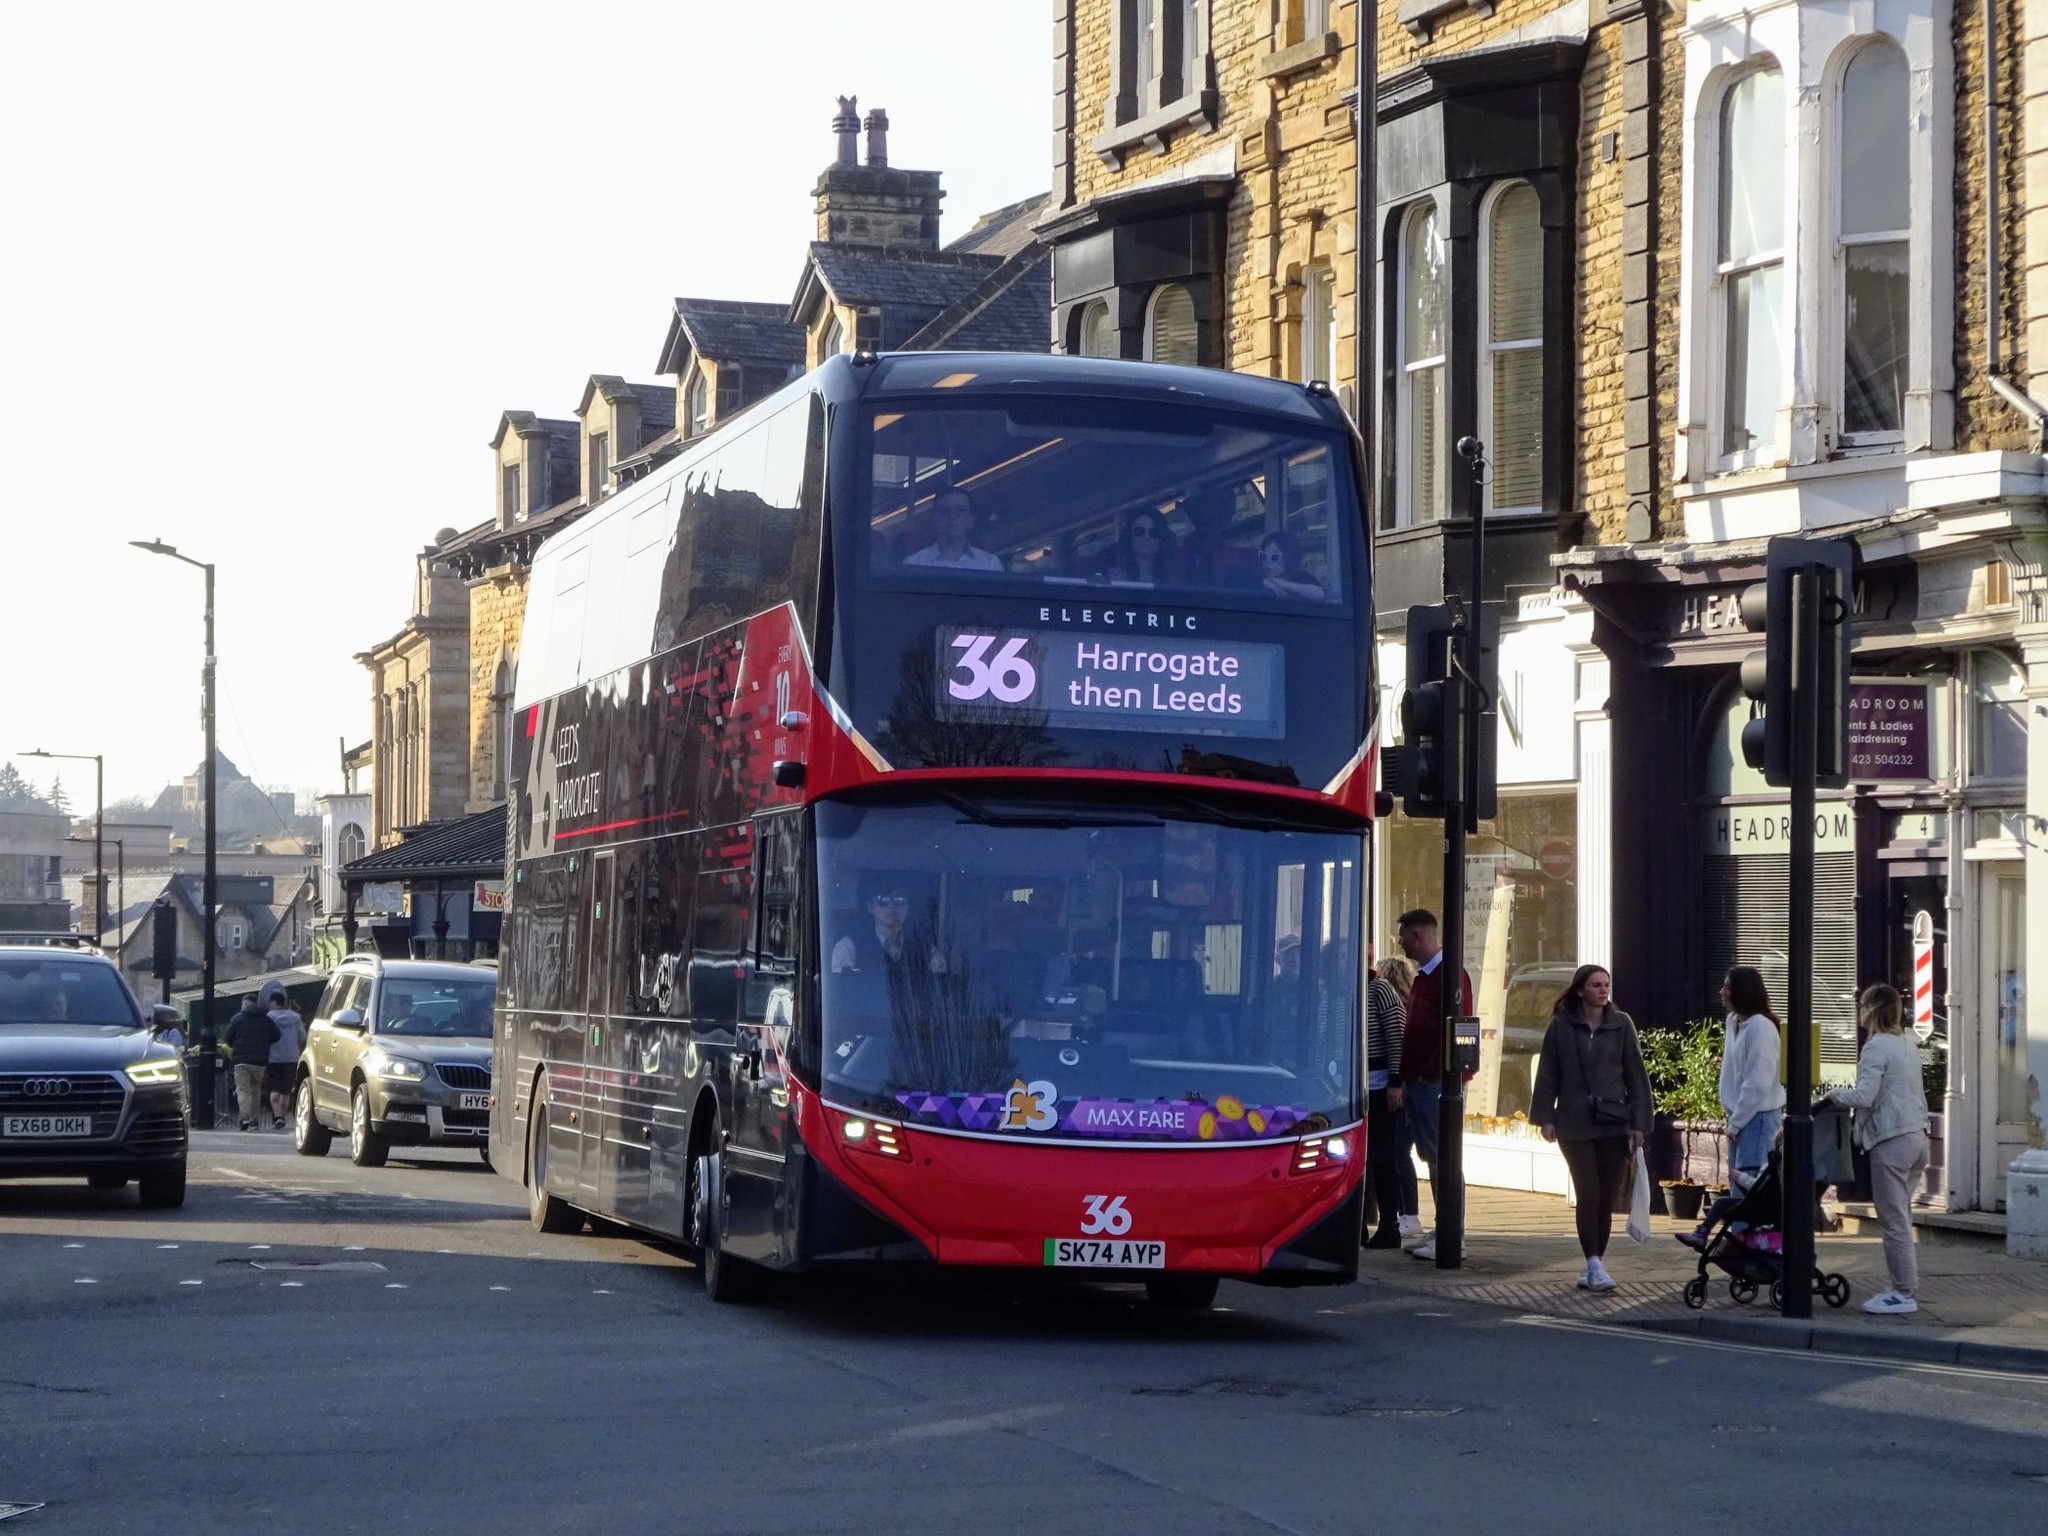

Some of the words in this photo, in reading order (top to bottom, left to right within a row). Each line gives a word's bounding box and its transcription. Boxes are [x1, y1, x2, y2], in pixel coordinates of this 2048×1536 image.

[1039, 607, 1197, 630] ELECTRIC
[948, 634, 1036, 703] 36
[1076, 642, 1239, 682] Harrogate
[1068, 676, 1142, 709] then
[1152, 683, 1242, 714] Leeds
[1849, 698, 1924, 710] ADROOM
[1870, 721, 1878, 730] &
[1880, 721, 1914, 731] Ladies
[555, 722, 580, 768] LEEDS
[1851, 754, 1871, 765] 423
[1874, 754, 1914, 765] 504232
[552, 771, 600, 822] HARROGATE
[1717, 813, 1848, 842] HEADROM
[1920, 816, 1928, 836] 4
[464, 1096, 489, 1107] HY6
[1000, 1080, 1058, 1131] £3
[1087, 1108, 1134, 1127] MAX
[1139, 1111, 1185, 1128] FARE
[10, 1119, 50, 1133] EX68
[55, 1119, 84, 1132] OKH
[1080, 1195, 1132, 1236] 36
[1058, 1242, 1114, 1263] SK74
[1120, 1244, 1161, 1264] AYP
